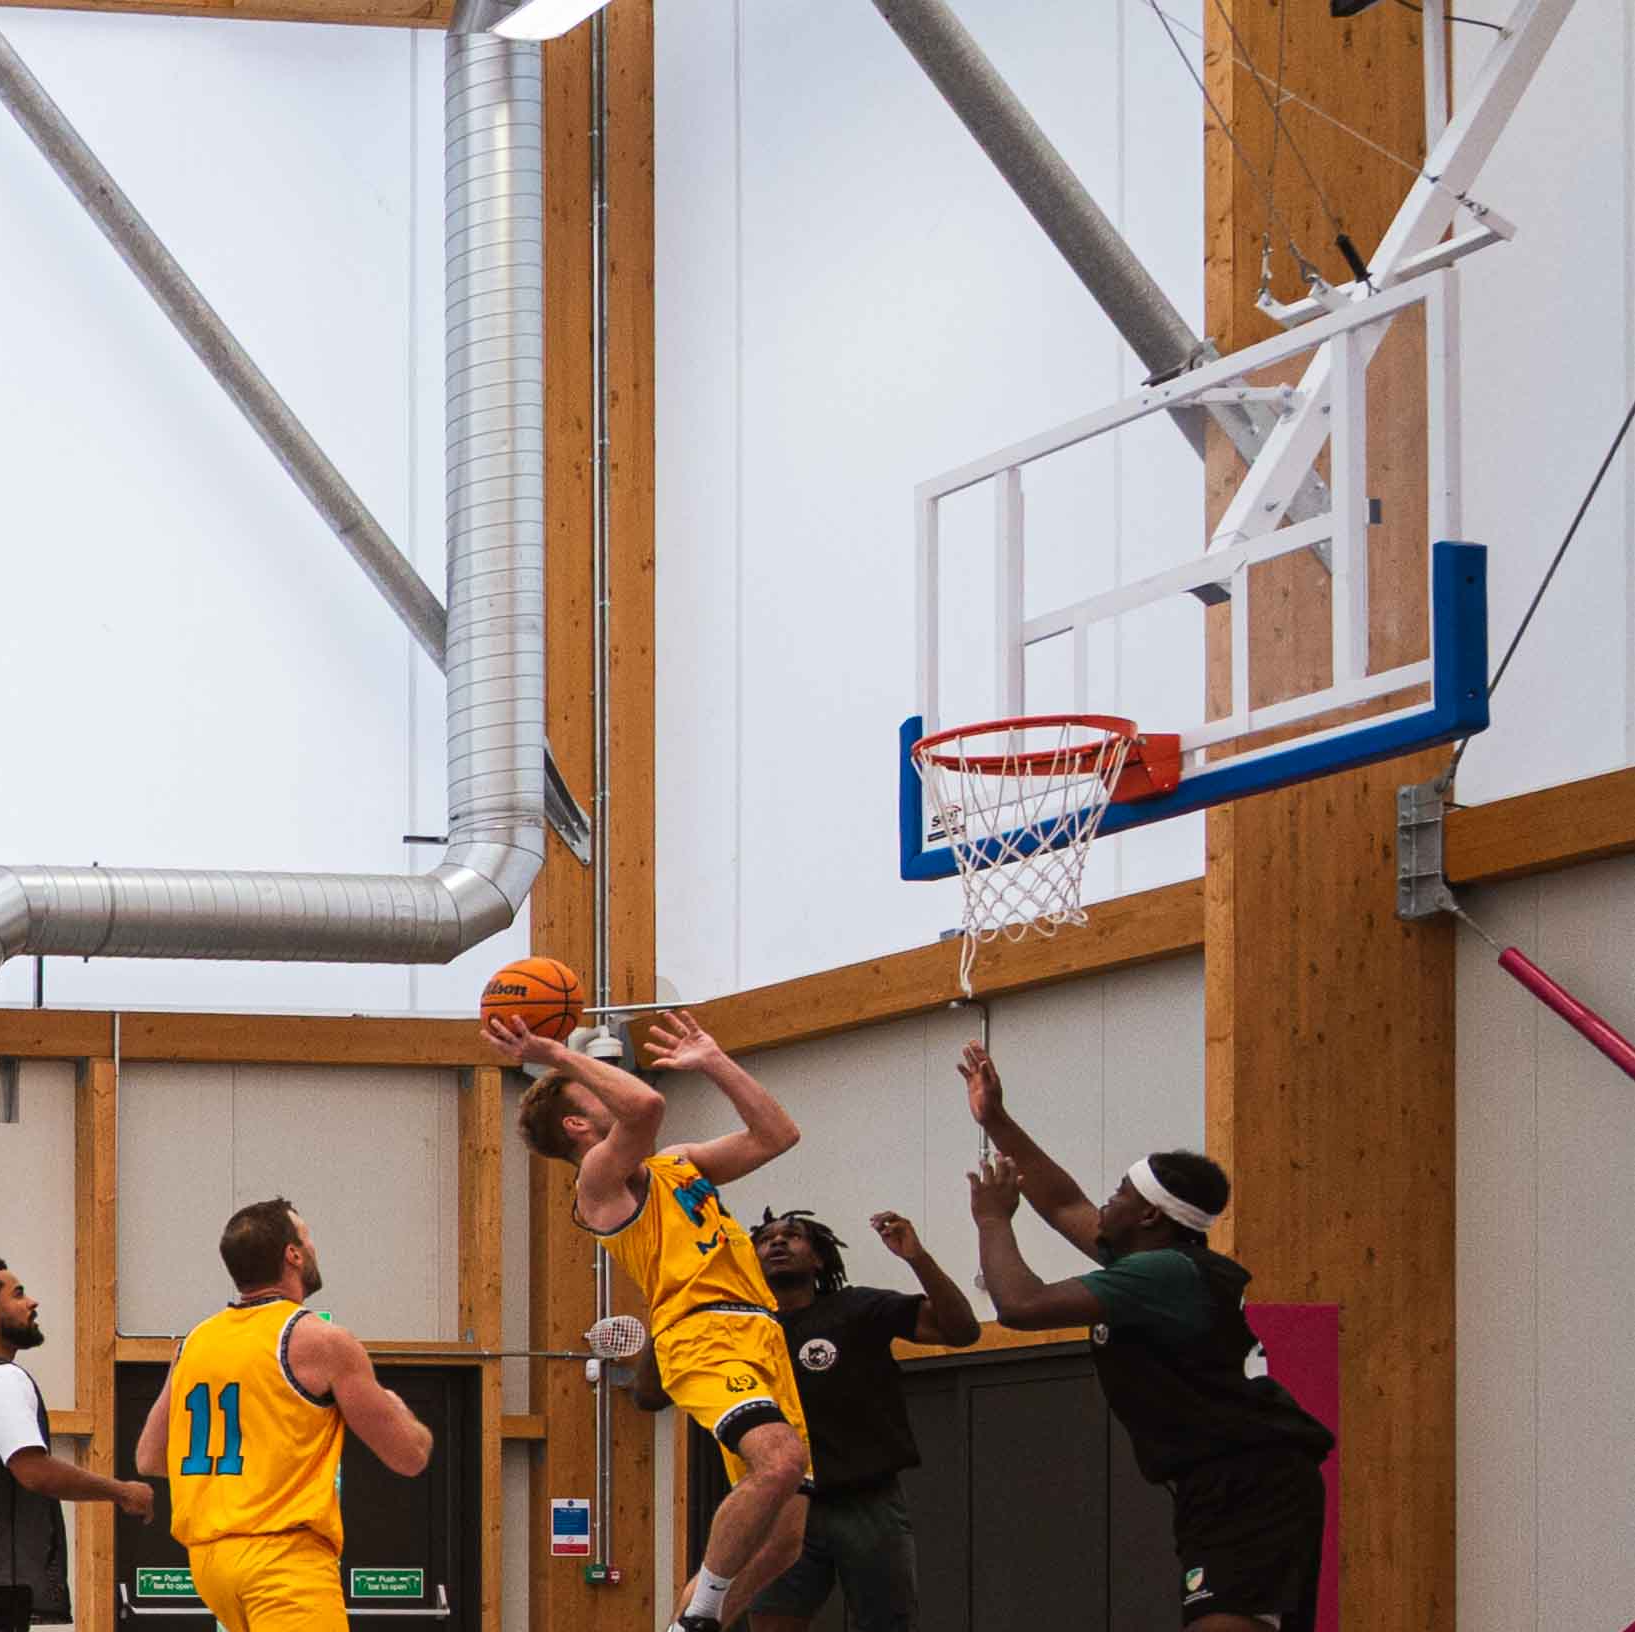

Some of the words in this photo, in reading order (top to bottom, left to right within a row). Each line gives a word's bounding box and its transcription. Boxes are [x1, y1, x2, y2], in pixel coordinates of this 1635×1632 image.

[181, 1382, 244, 1476] 11
[164, 1574, 183, 1583] Push
[378, 1575, 396, 1583] Push
